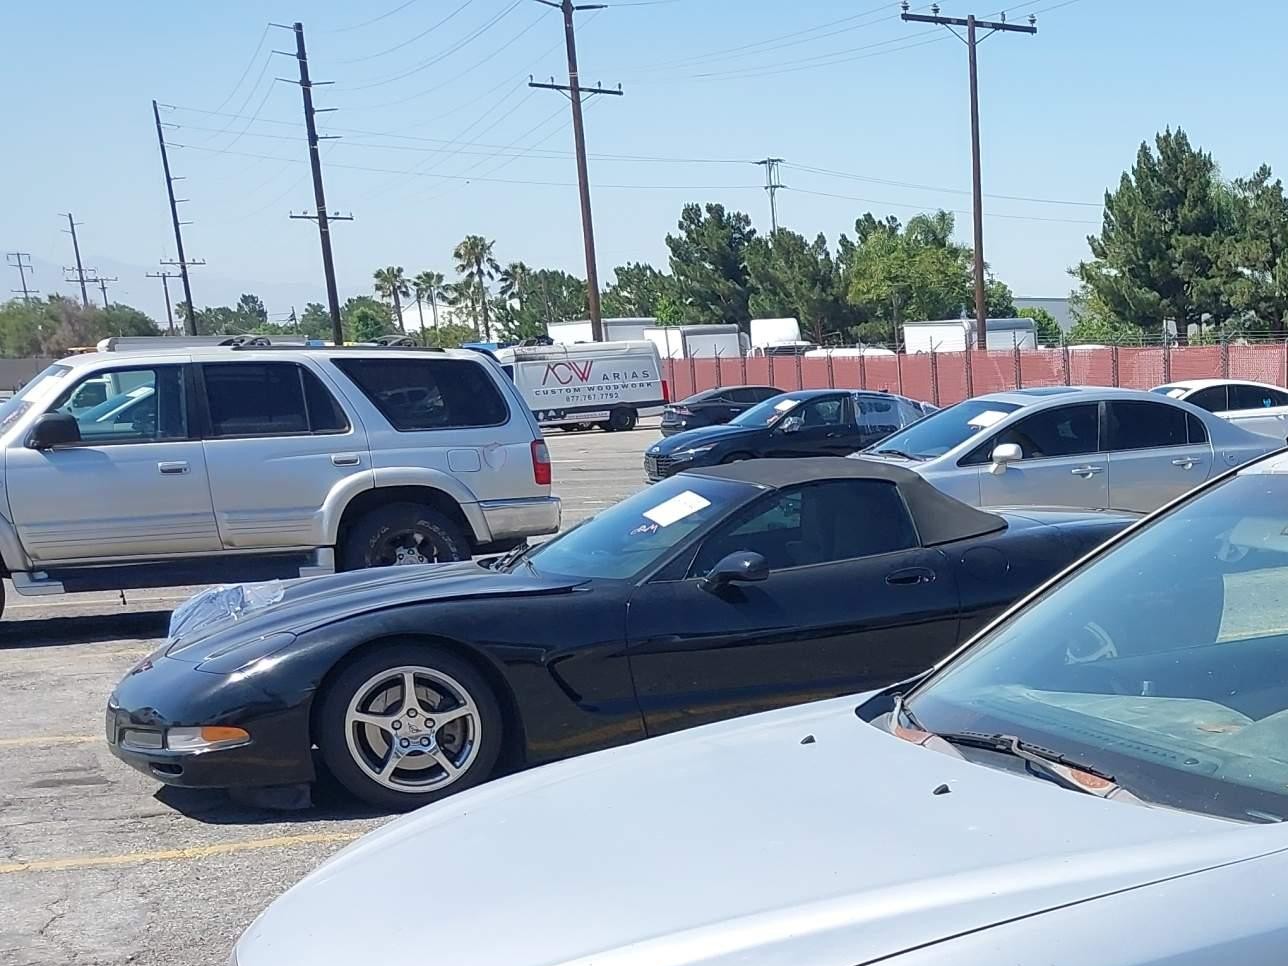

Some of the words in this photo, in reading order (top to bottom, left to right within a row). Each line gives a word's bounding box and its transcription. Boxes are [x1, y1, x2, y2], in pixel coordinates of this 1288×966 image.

[602, 370, 650, 382] ARIAS
[535, 387, 581, 396] CUSTOM
[587, 382, 653, 393] WOODWORK
